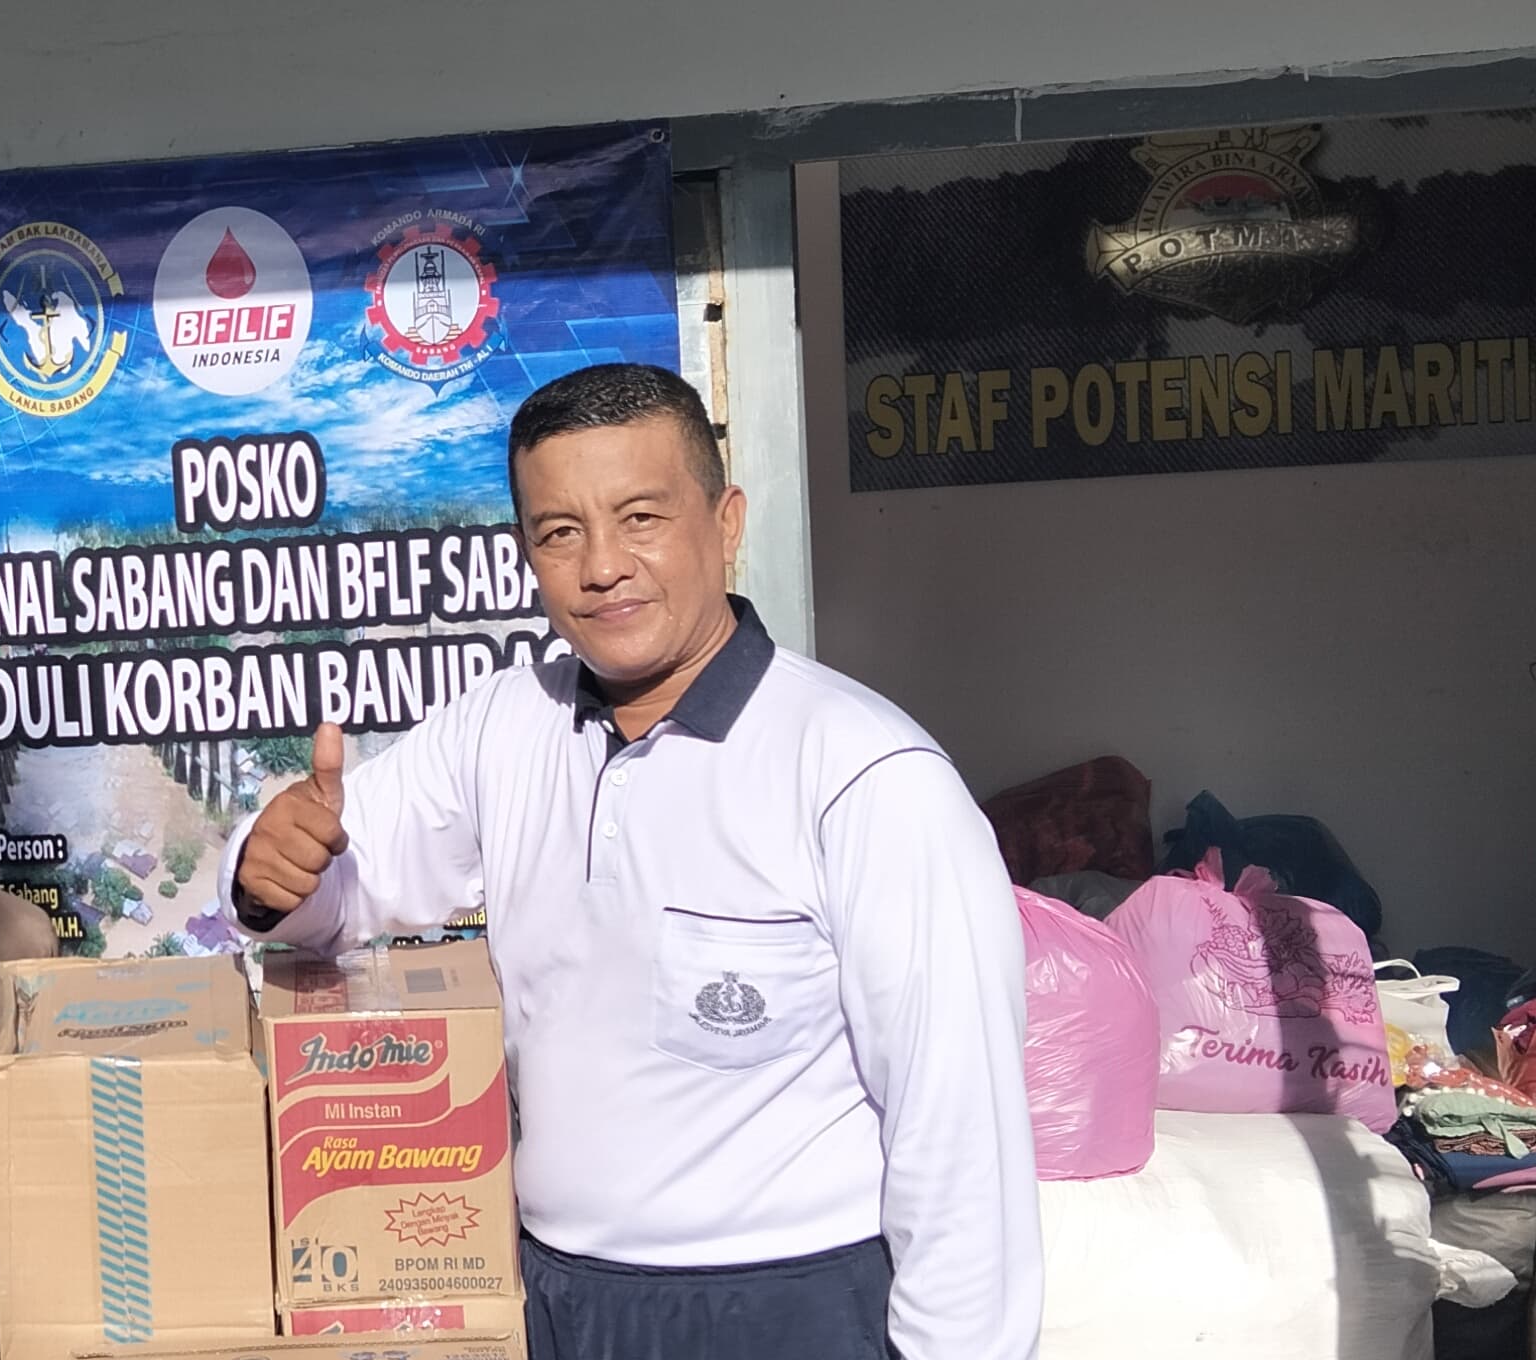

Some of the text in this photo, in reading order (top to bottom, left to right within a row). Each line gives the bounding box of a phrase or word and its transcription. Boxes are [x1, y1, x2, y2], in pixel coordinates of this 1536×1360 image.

[1211, 150, 1258, 169] BINA
[371, 209, 422, 247] KOMANDO
[426, 208, 473, 231] ARMADA
[174, 304, 293, 345] BFLF
[192, 348, 281, 368] INDONESIA
[377, 352, 421, 380] KOMANDO
[8, 387, 95, 413] LANAL SABANG
[865, 369, 1011, 459] STAF
[1029, 351, 1294, 448] POTENSI
[181, 441, 318, 524] POSKO
[72, 549, 235, 633] SABANG
[241, 545, 330, 624] DAN
[337, 539, 432, 619] BFLF
[103, 653, 307, 736] KORBAN
[1180, 1024, 1389, 1087] Terima Kasih
[349, 1103, 402, 1119] Instan
[323, 1136, 358, 1150] Rasa
[302, 1144, 483, 1178] Ayam Bawang
[395, 1256, 486, 1271] BPOM RI MD
[378, 1276, 504, 1292] 240935004600027
